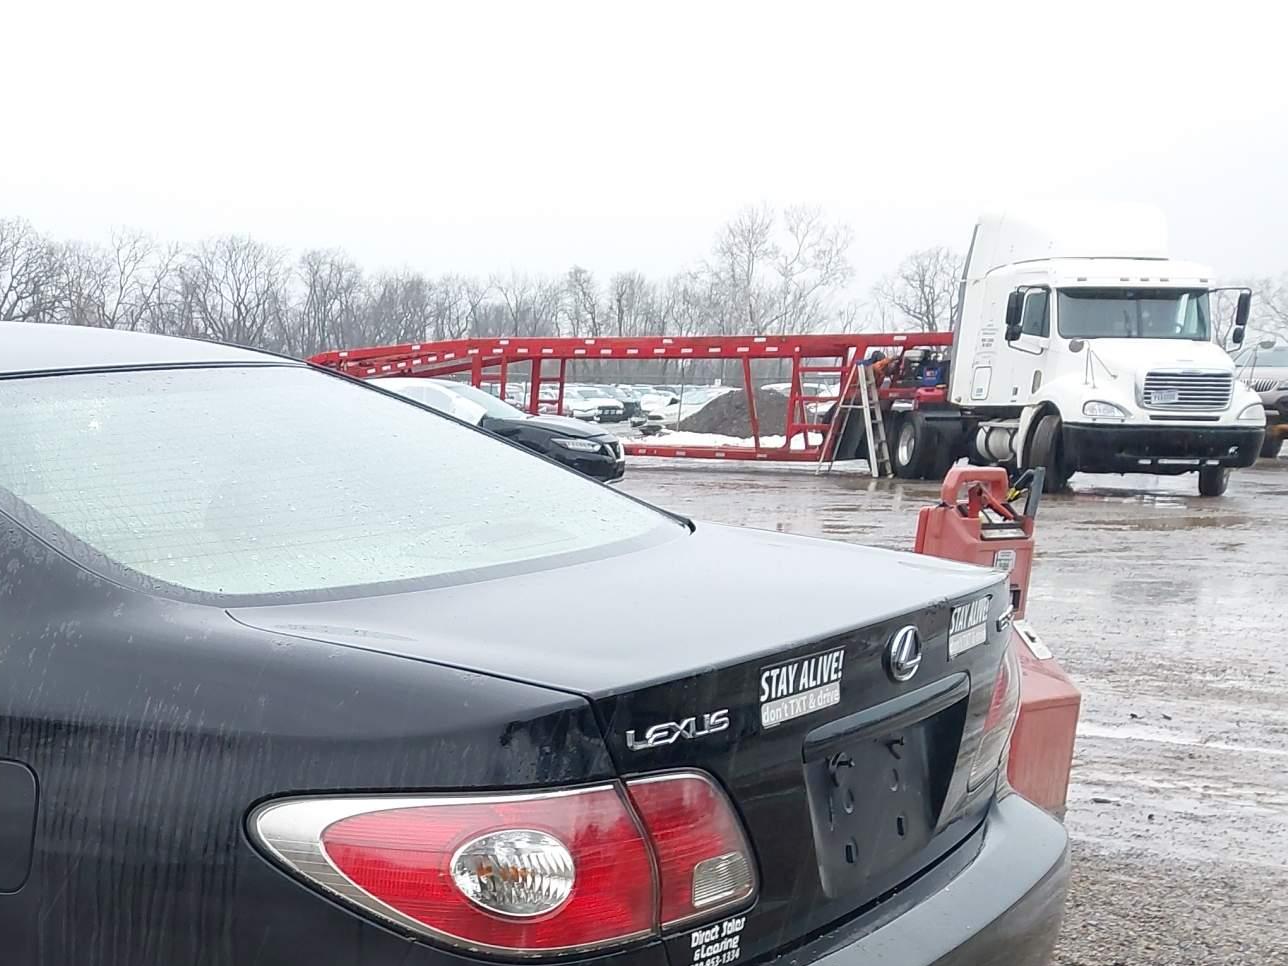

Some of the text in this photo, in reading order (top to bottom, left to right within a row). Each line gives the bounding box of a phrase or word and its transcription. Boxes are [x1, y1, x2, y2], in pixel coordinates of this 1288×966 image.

[950, 603, 971, 634] STAY
[760, 650, 845, 702] STAY ALIVE!
[762, 688, 840, 724] don't TXT & drive
[626, 709, 730, 751] LEXUS
[691, 917, 746, 948] Direct Sales
